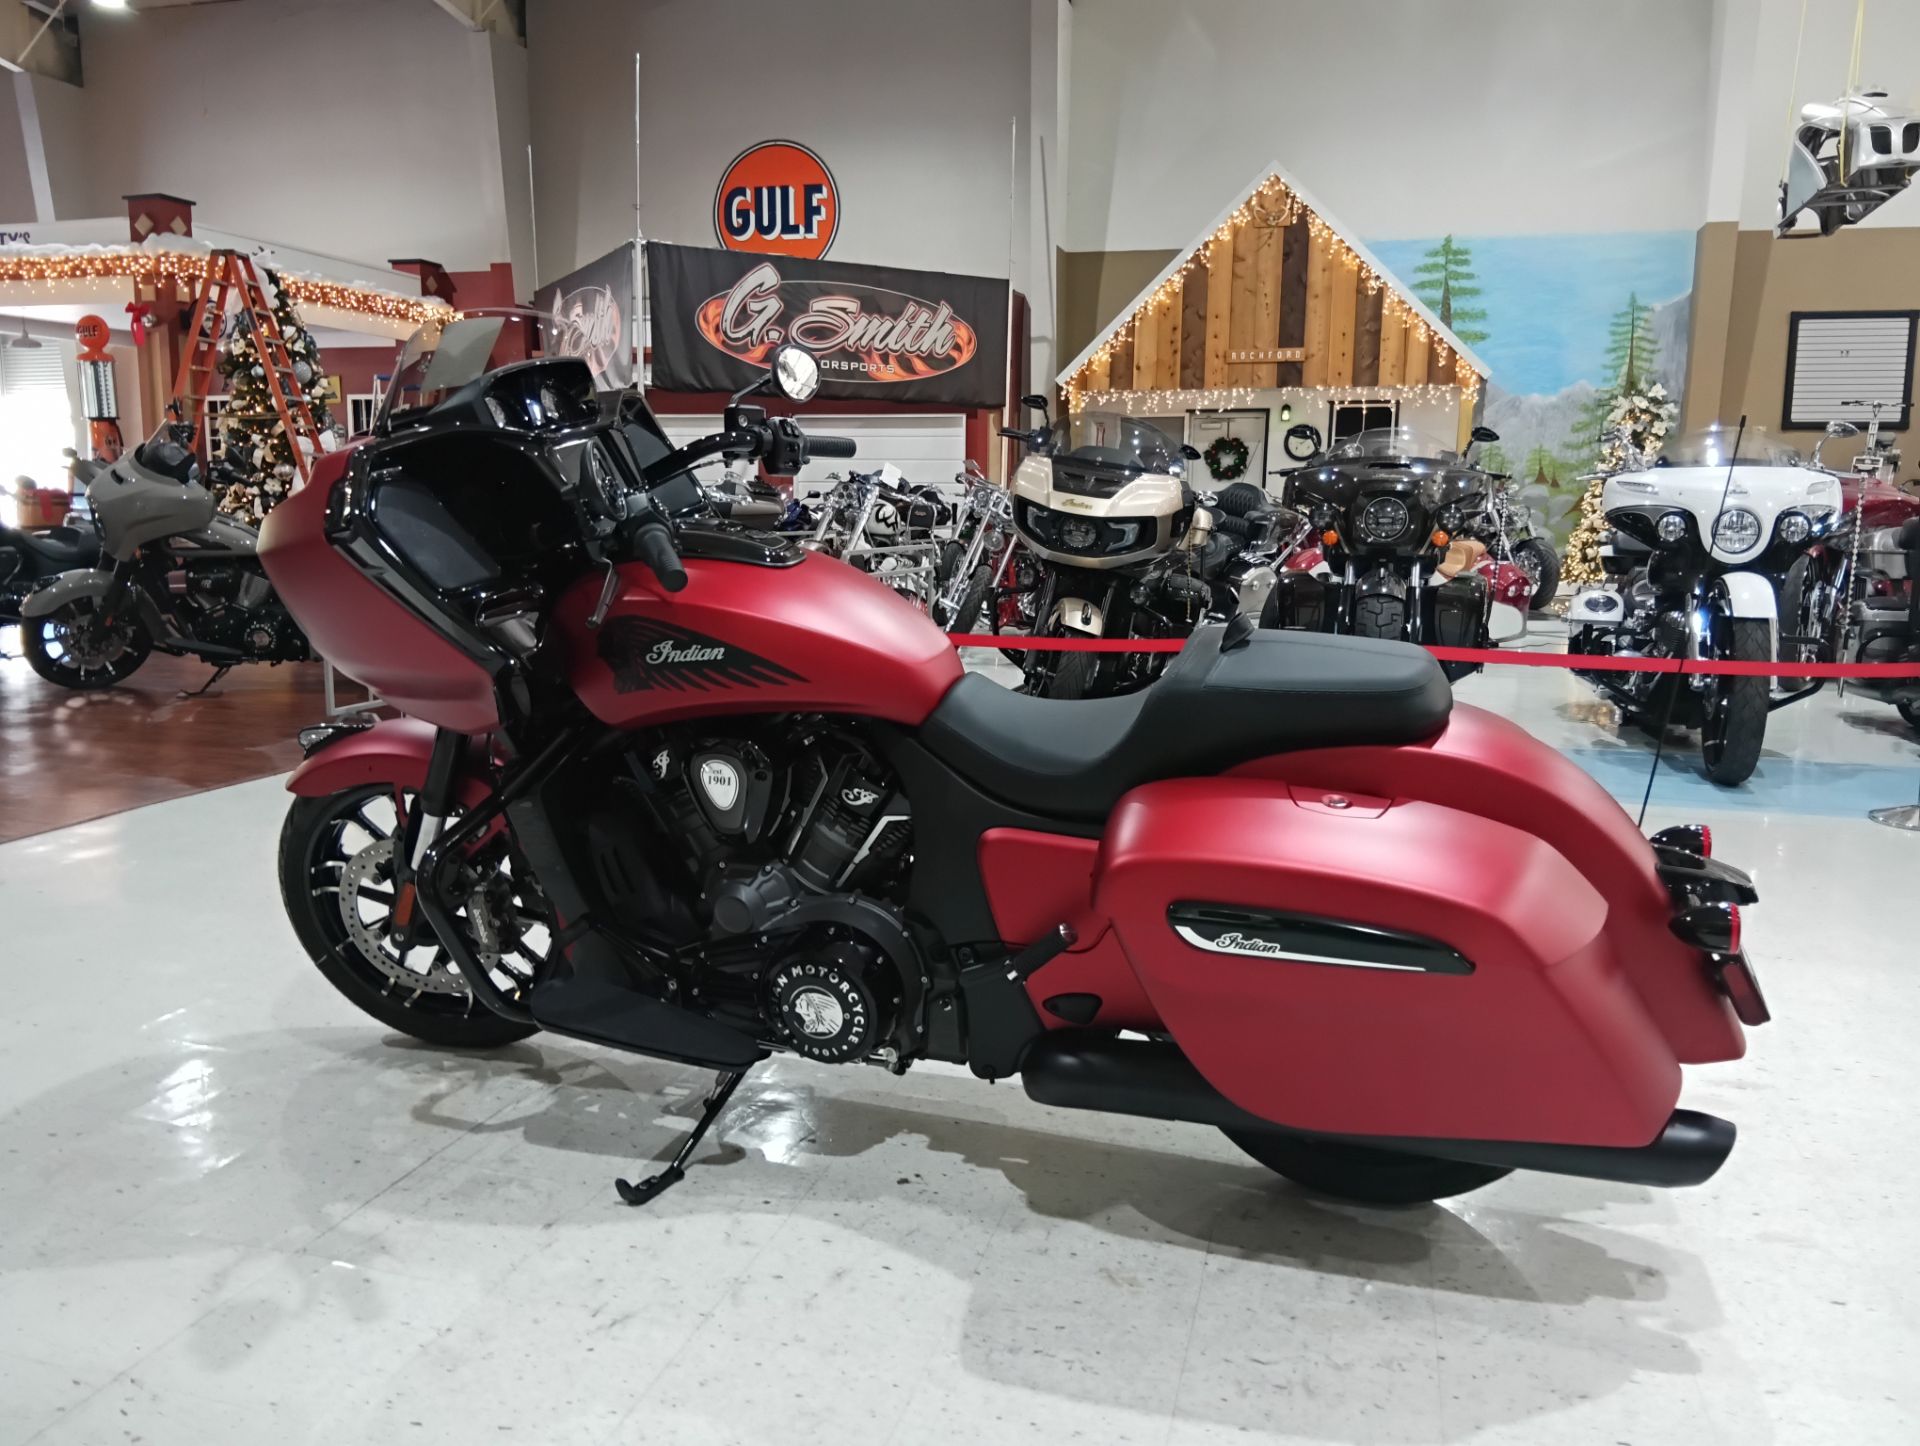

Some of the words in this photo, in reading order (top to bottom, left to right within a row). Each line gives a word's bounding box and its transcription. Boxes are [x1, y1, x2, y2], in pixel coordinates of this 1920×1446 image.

[724, 184, 828, 241] GULF
[720, 262, 784, 347] G.
[789, 297, 953, 356] Smith
[820, 359, 896, 374] ORSPORTS
[1231, 350, 1301, 361] ROCHFORD
[645, 640, 725, 665] Indian
[708, 775, 732, 786] 1901
[1215, 933, 1279, 953] Indian
[791, 963, 866, 1045] MOTORCYCLE
